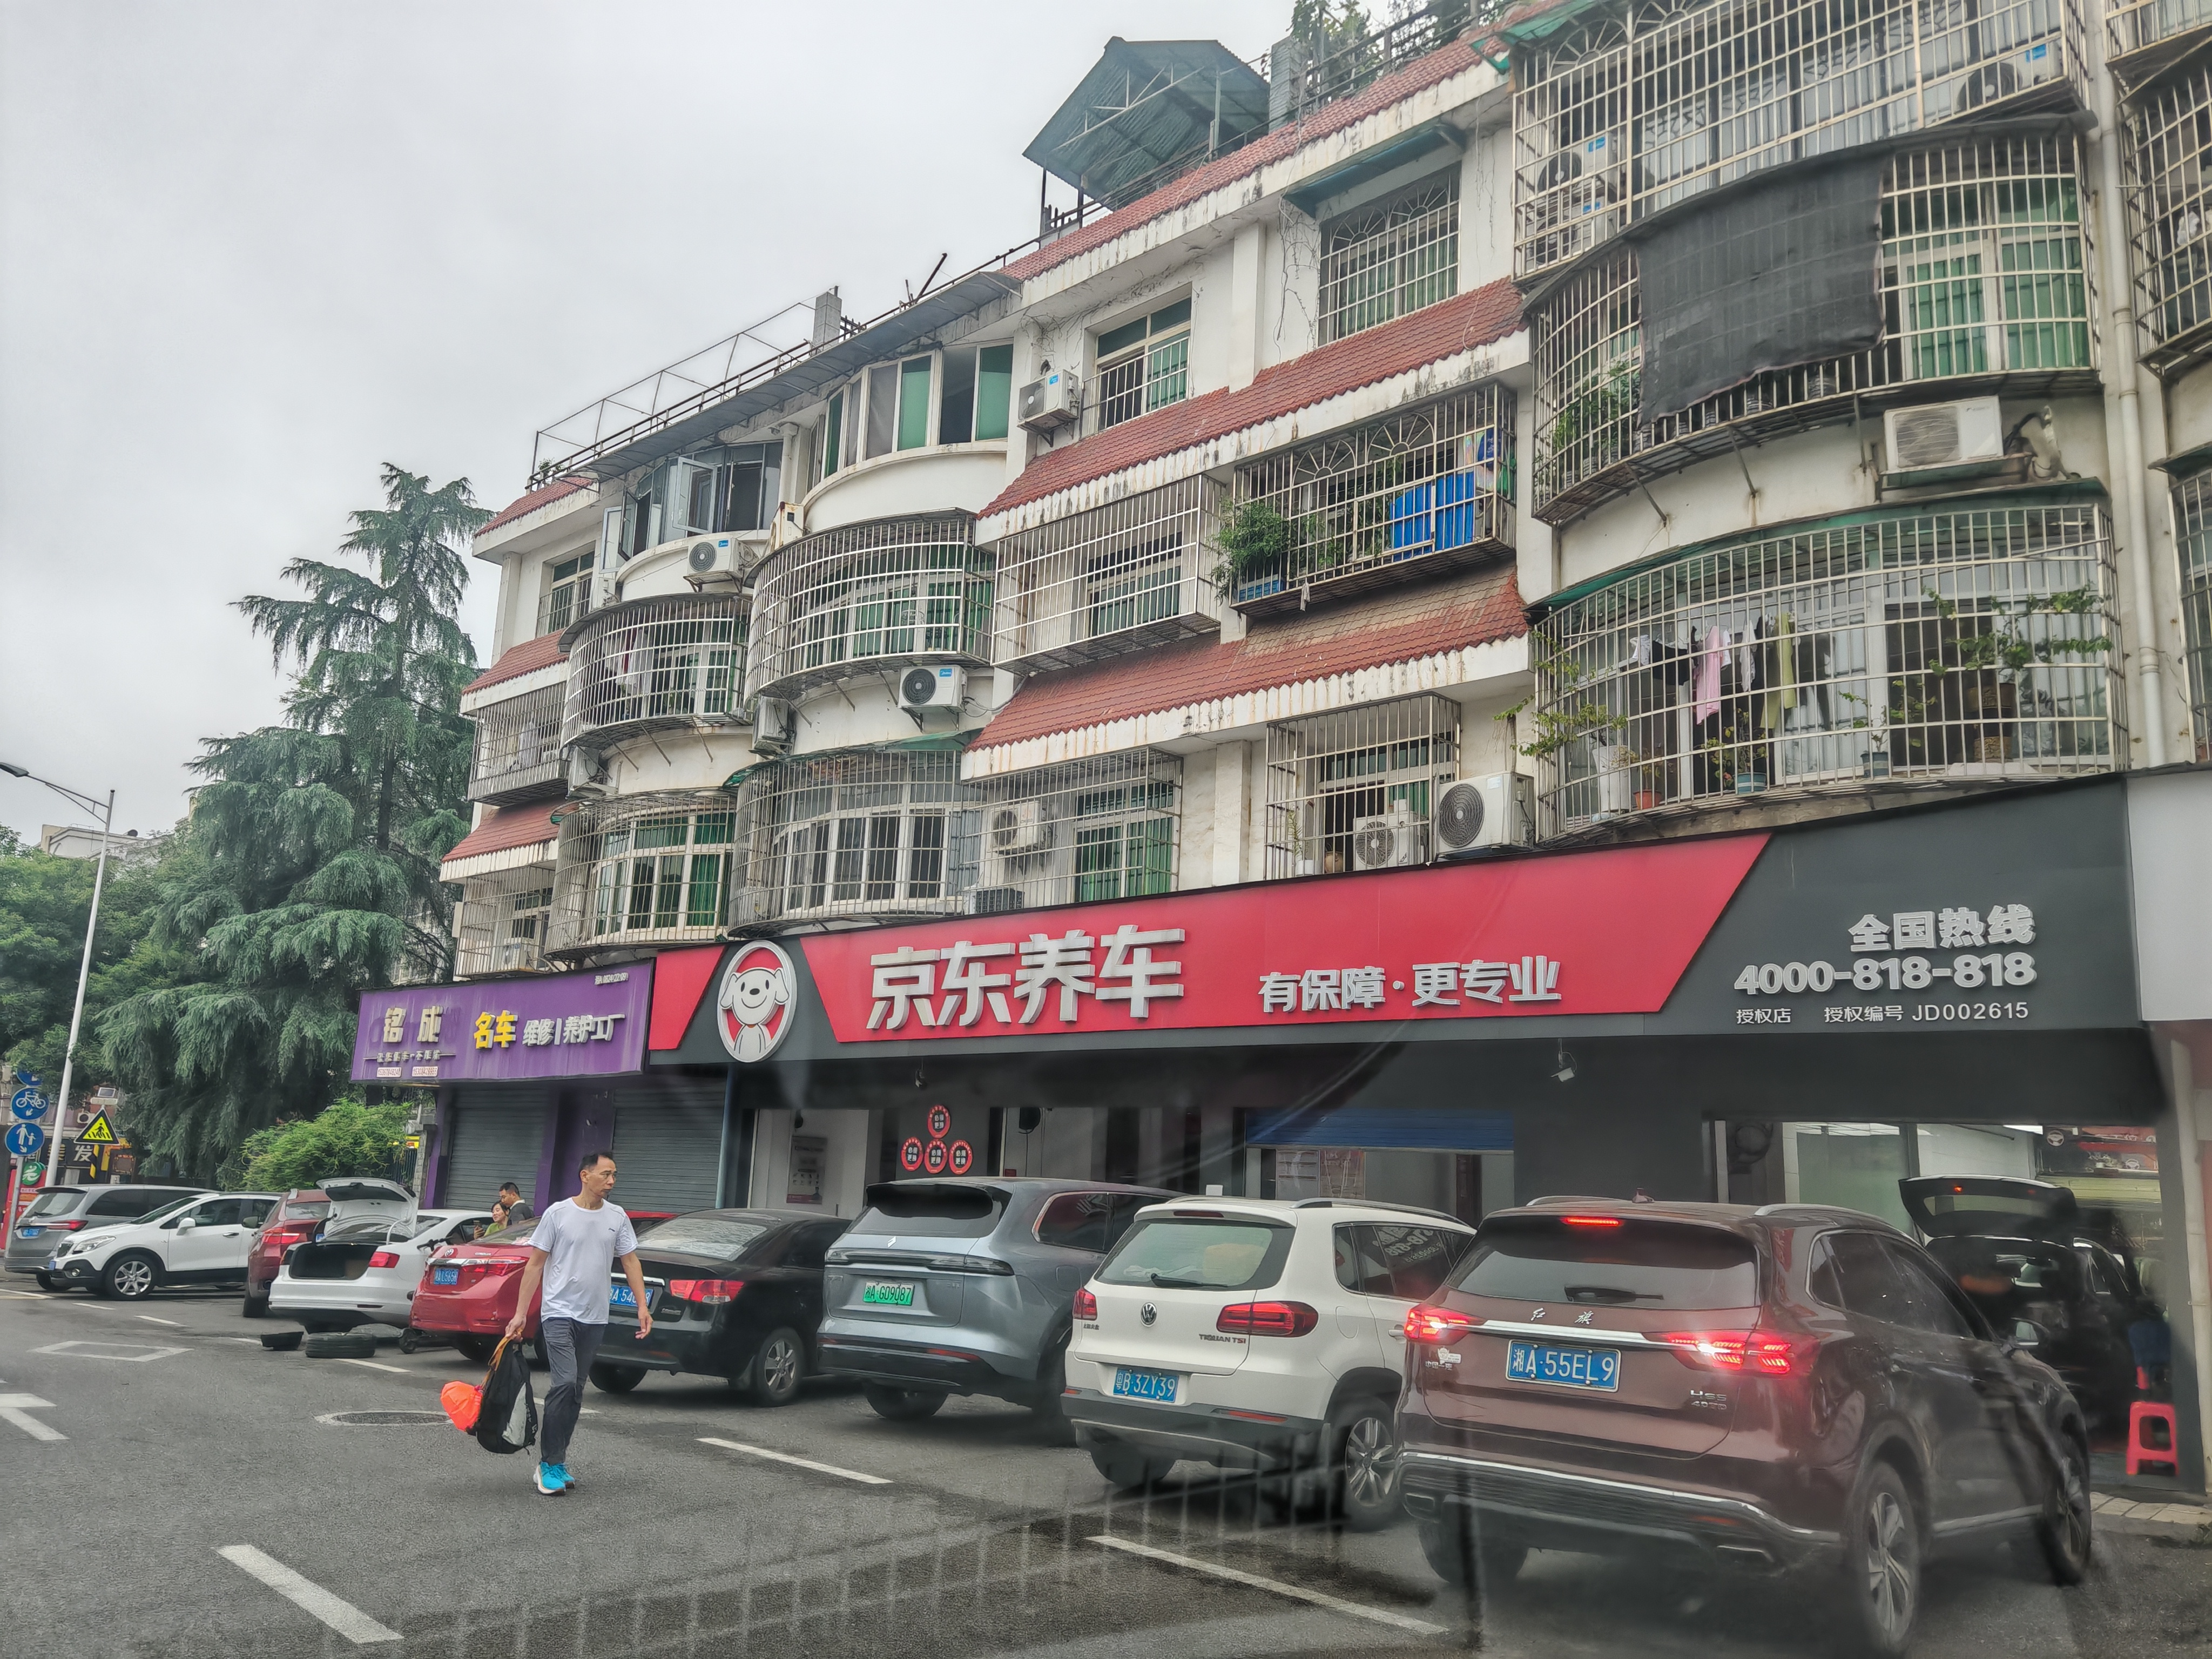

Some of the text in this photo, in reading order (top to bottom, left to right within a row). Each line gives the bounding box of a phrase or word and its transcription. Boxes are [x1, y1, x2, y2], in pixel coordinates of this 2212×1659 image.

[1848, 904, 2036, 953] 全国热线
[866, 925, 1185, 1029] 京东养车
[1258, 955, 1562, 1013] 有保障·更专业
[1734, 952, 2037, 995] 4000-818-818
[474, 1010, 518, 1049] 名车
[1736, 1002, 2029, 1024] 授权店 授权编号 JD002615
